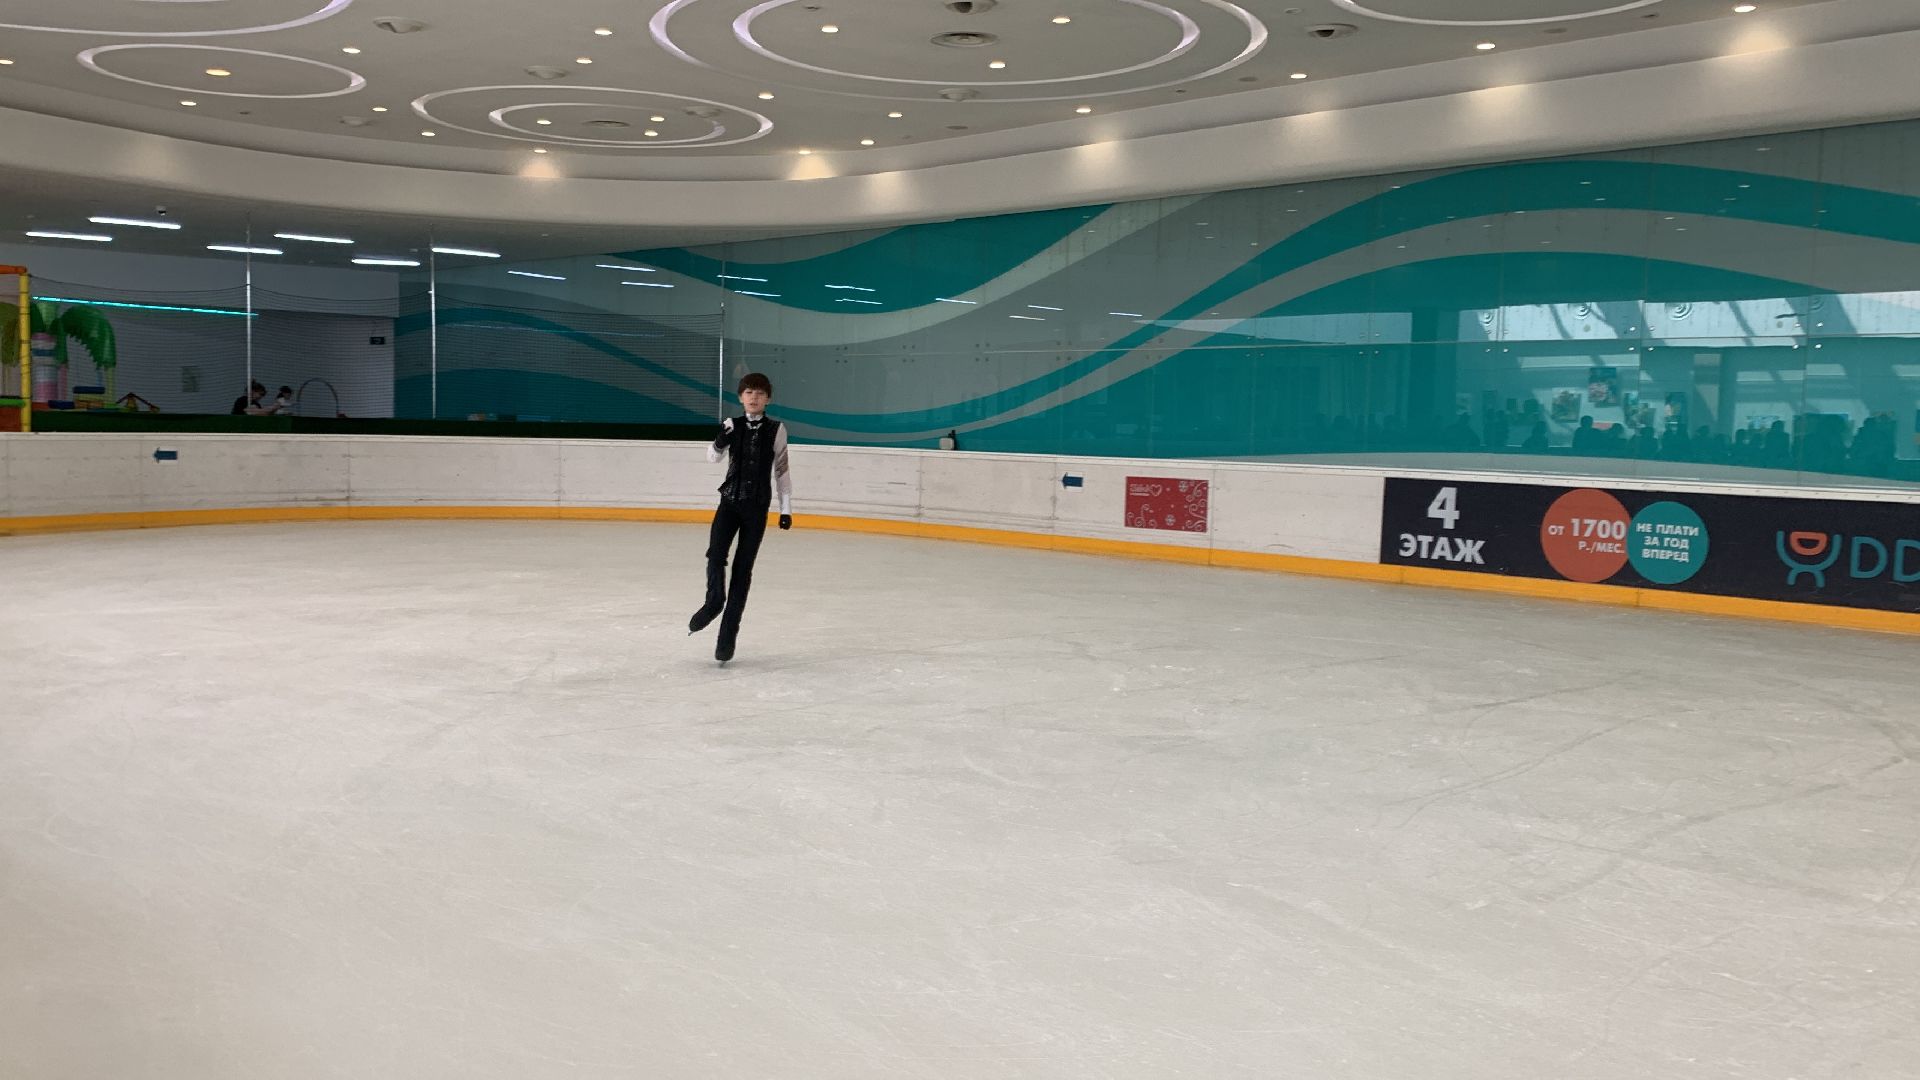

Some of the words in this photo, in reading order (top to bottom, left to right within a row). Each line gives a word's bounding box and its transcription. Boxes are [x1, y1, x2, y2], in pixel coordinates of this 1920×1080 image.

[1427, 486, 1460, 530] 4
[1571, 518, 1626, 540] 1700
[1636, 523, 1653, 533] НЕ
[1656, 523, 1699, 536] ПЛАТИ
[1398, 533, 1487, 565] ЭТАЖ
[1643, 535, 1660, 547] ЗА
[1663, 537, 1690, 549] ГОД
[1642, 549, 1689, 562] ВПЕРЕД
